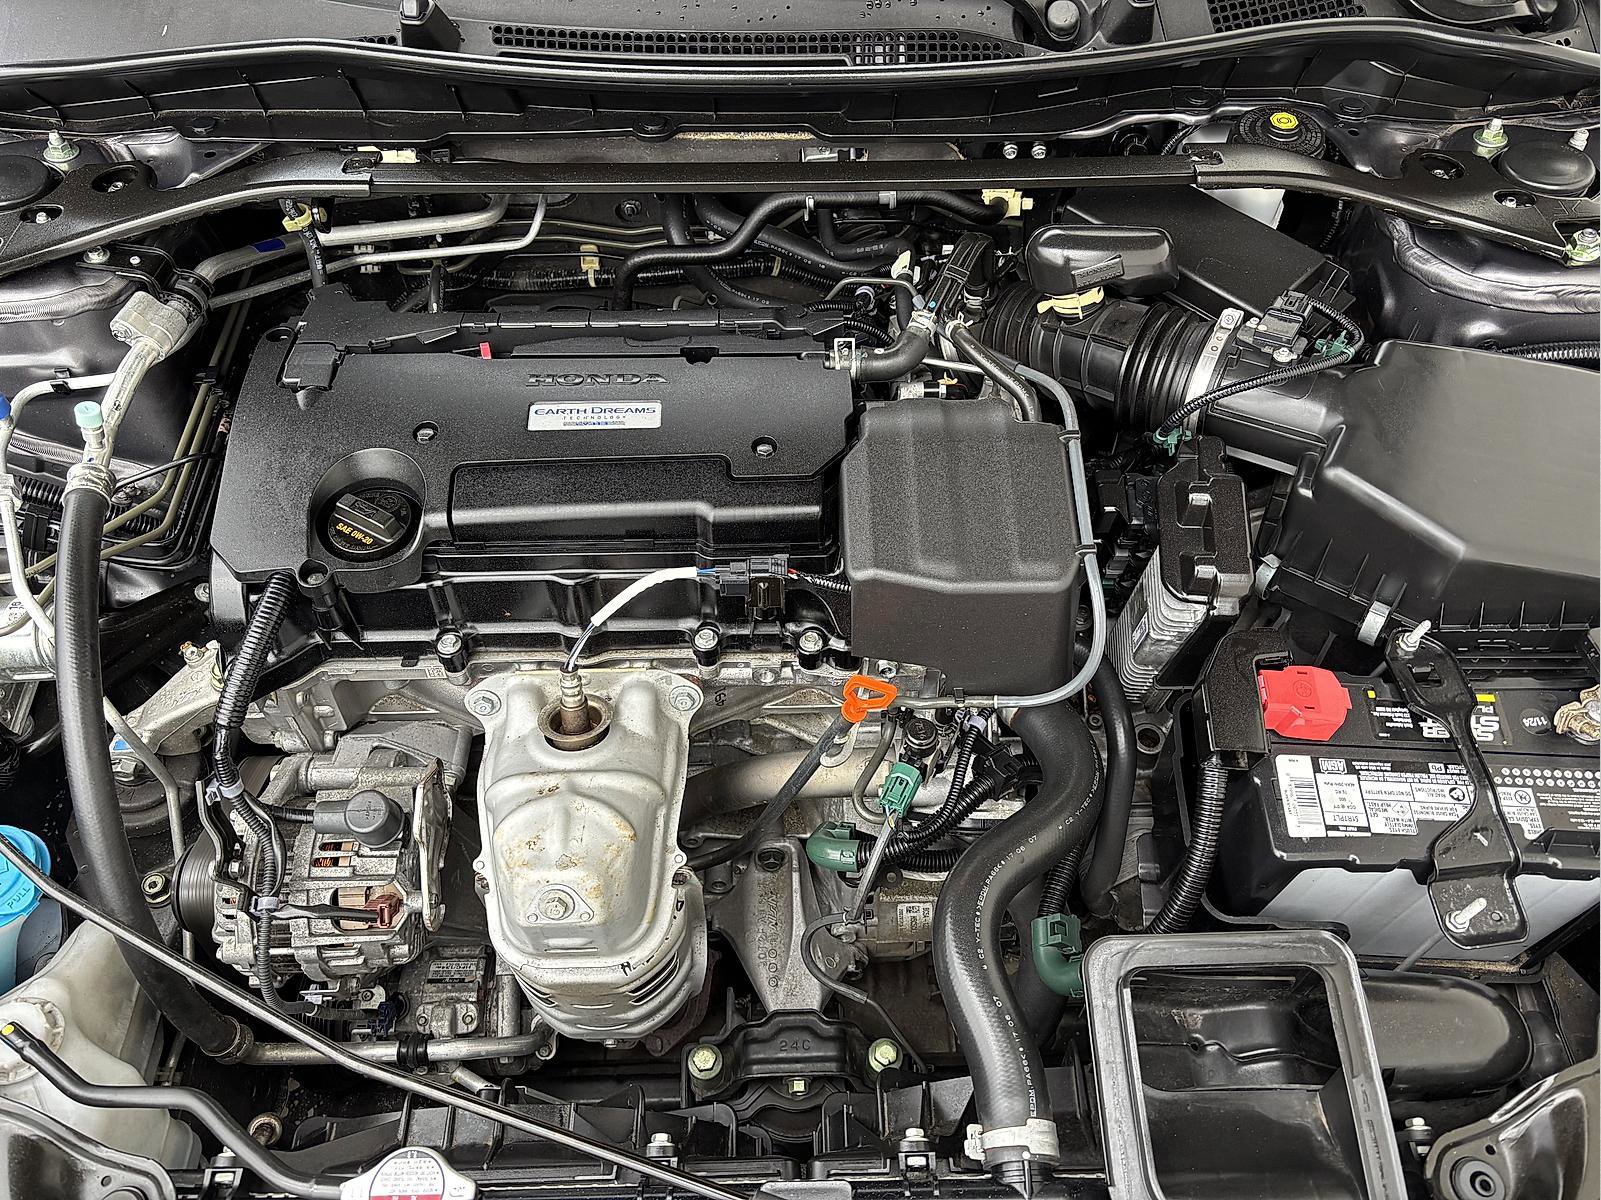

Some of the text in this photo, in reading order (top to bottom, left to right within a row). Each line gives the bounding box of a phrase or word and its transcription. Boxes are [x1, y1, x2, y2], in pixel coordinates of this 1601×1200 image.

[525, 373, 670, 387] HONDA
[534, 406, 656, 416] EARTH DREAMS
[336, 522, 373, 545] SAE 0W-20
[1321, 760, 1344, 772] AGM
[1028, 835, 1037, 843] 07
[7, 887, 31, 909] PULL
[992, 995, 1002, 1007] 07
